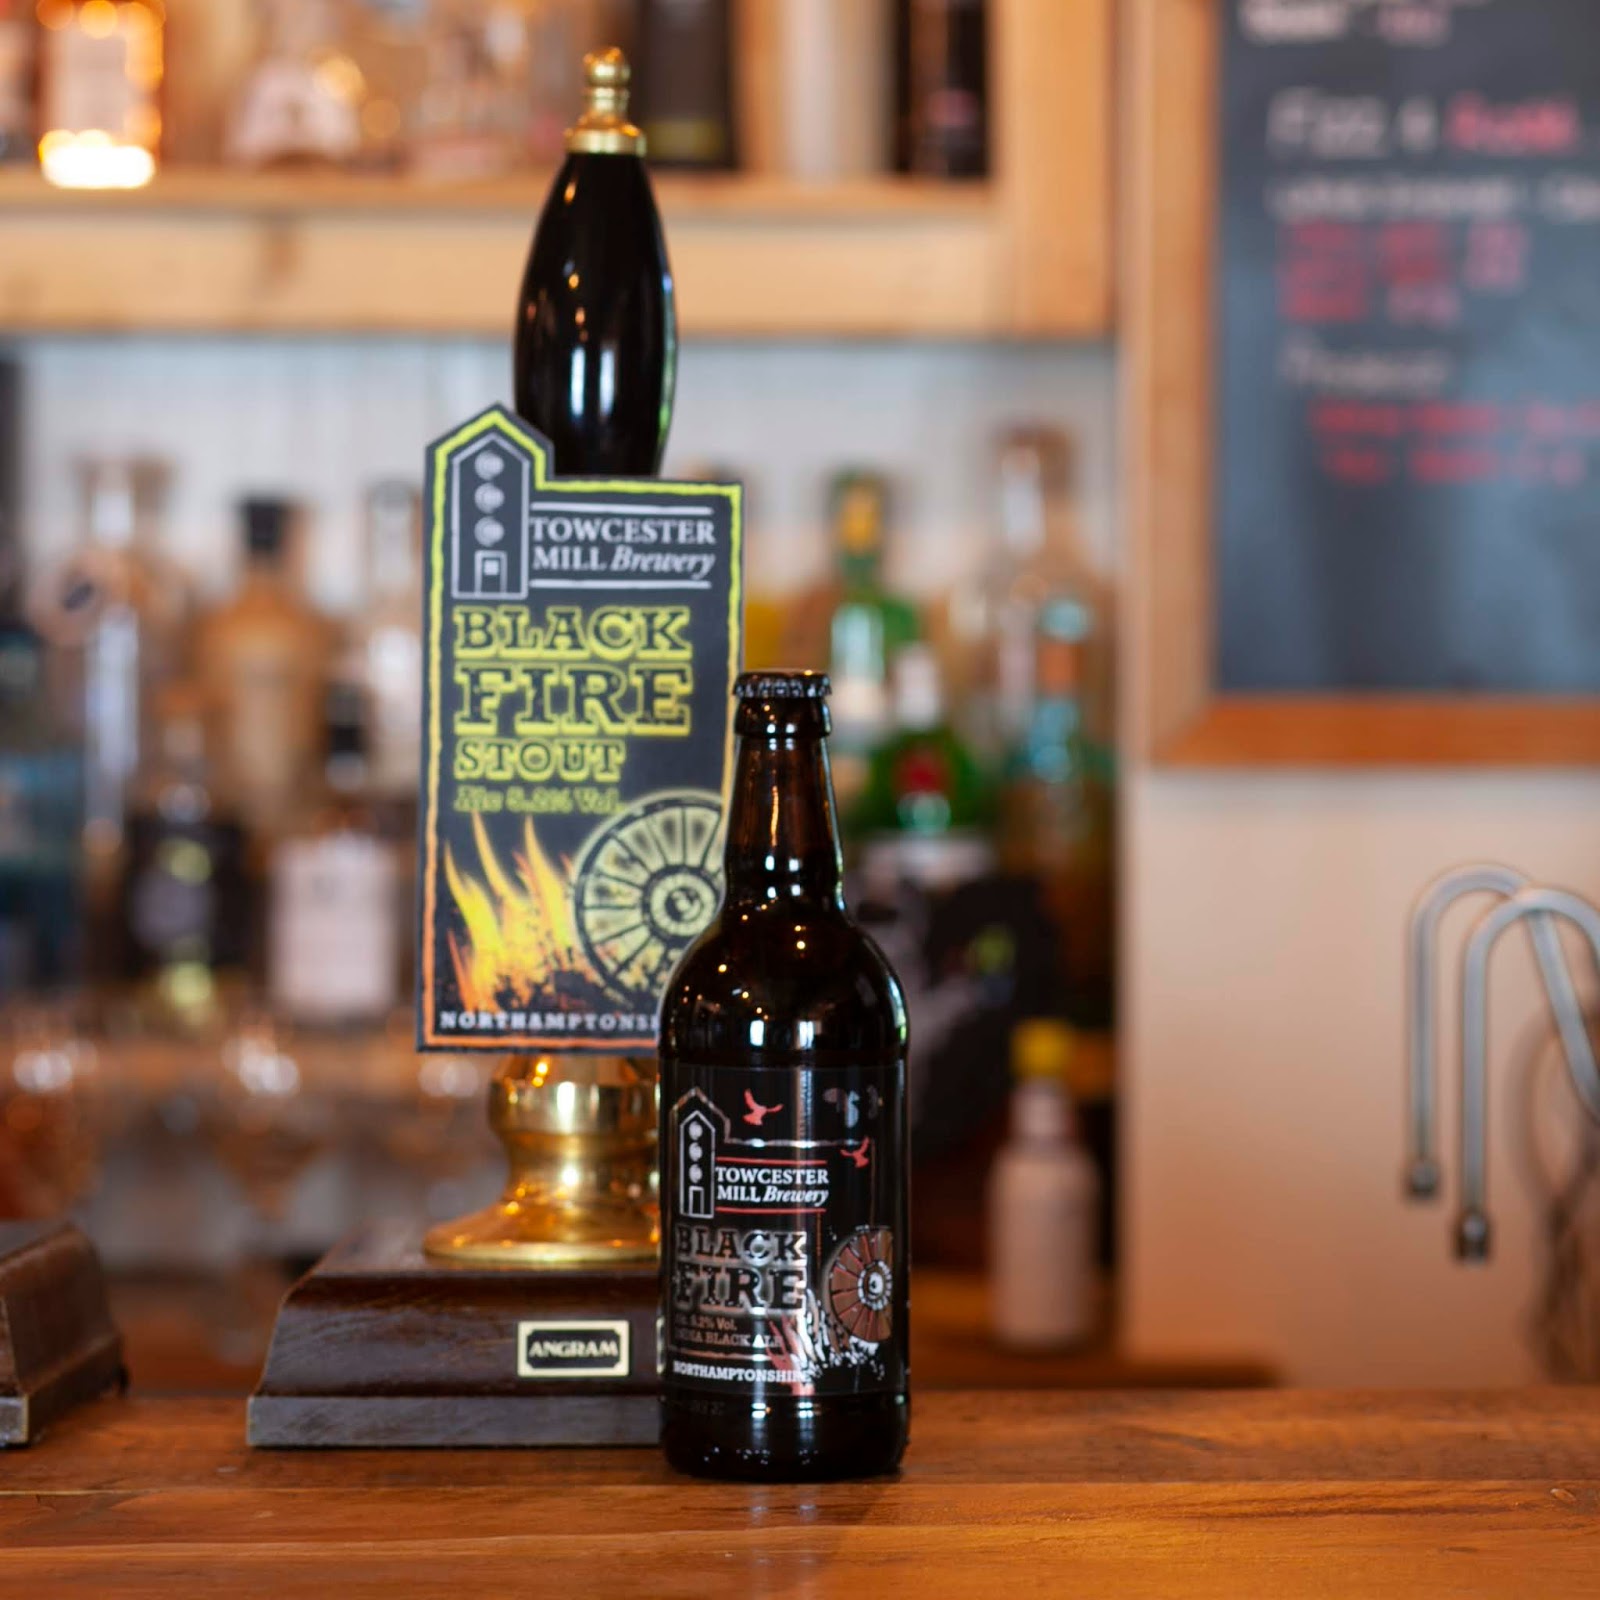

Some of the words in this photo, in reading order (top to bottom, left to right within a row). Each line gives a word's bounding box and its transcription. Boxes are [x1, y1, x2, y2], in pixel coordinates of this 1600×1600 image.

[530, 517, 716, 545] TOWCESTER
[532, 546, 606, 571] MILL
[610, 545, 716, 580] Brewery
[453, 605, 692, 660] BLACK
[453, 662, 692, 735] FIRE
[454, 737, 626, 783] STOUT
[440, 1011, 659, 1031] NORTHAMPTONS
[715, 1166, 829, 1185] TOWCESTER
[717, 1184, 761, 1203] MILL
[763, 1185, 829, 1207] Brewery
[675, 1223, 807, 1267] BLACK
[672, 1262, 807, 1315] FIRE
[528, 1340, 619, 1358] ANGRAM
[706, 1330, 751, 1348] BLACK
